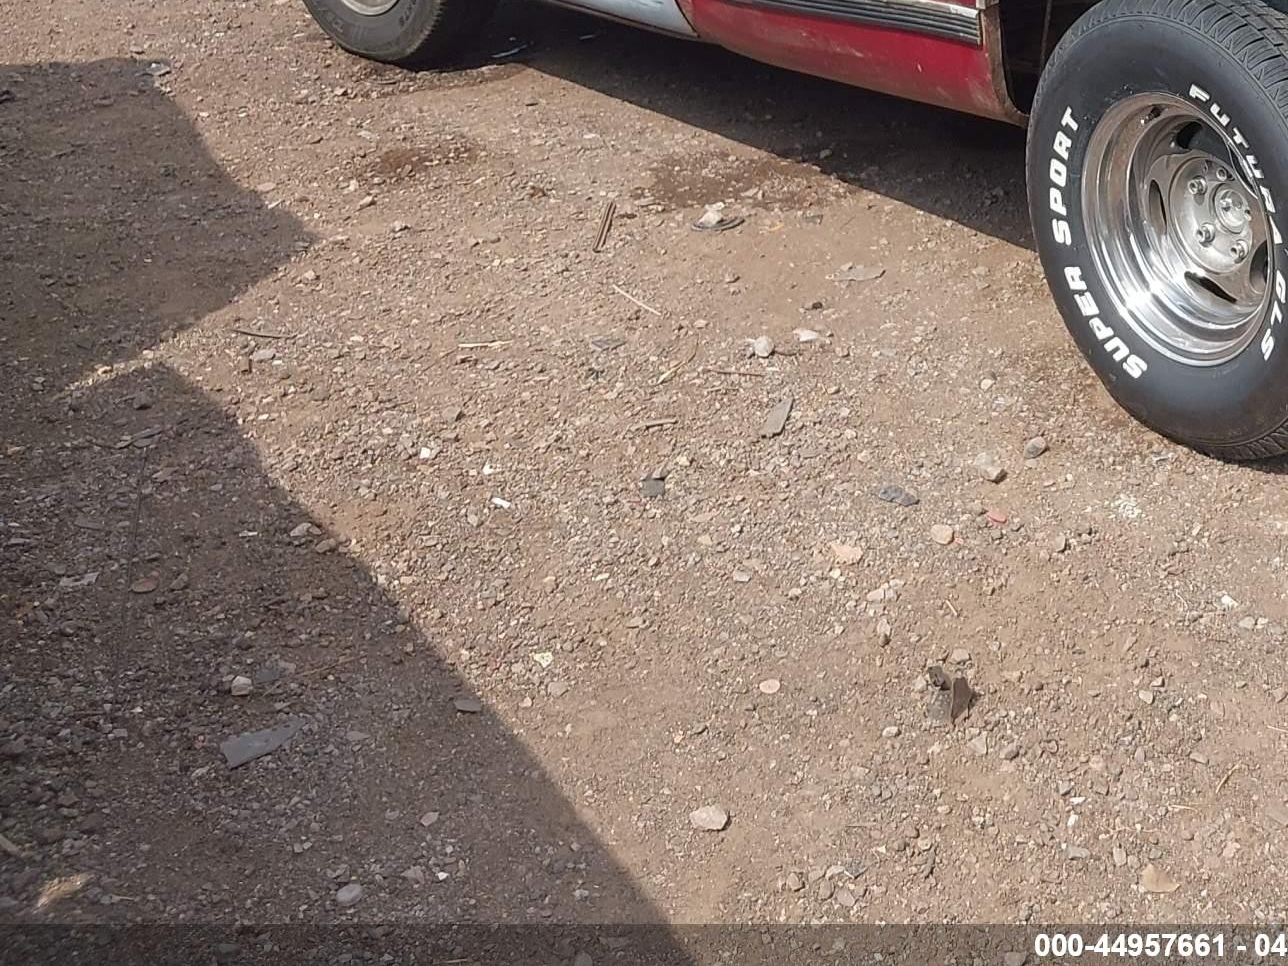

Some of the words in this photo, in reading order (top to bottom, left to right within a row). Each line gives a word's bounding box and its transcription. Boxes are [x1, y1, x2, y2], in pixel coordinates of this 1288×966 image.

[1049, 106, 1081, 246] SPORT
[1189, 84, 1283, 244] FUTURA
[1260, 269, 1286, 361] GLS
[1064, 265, 1148, 379] SUPER
